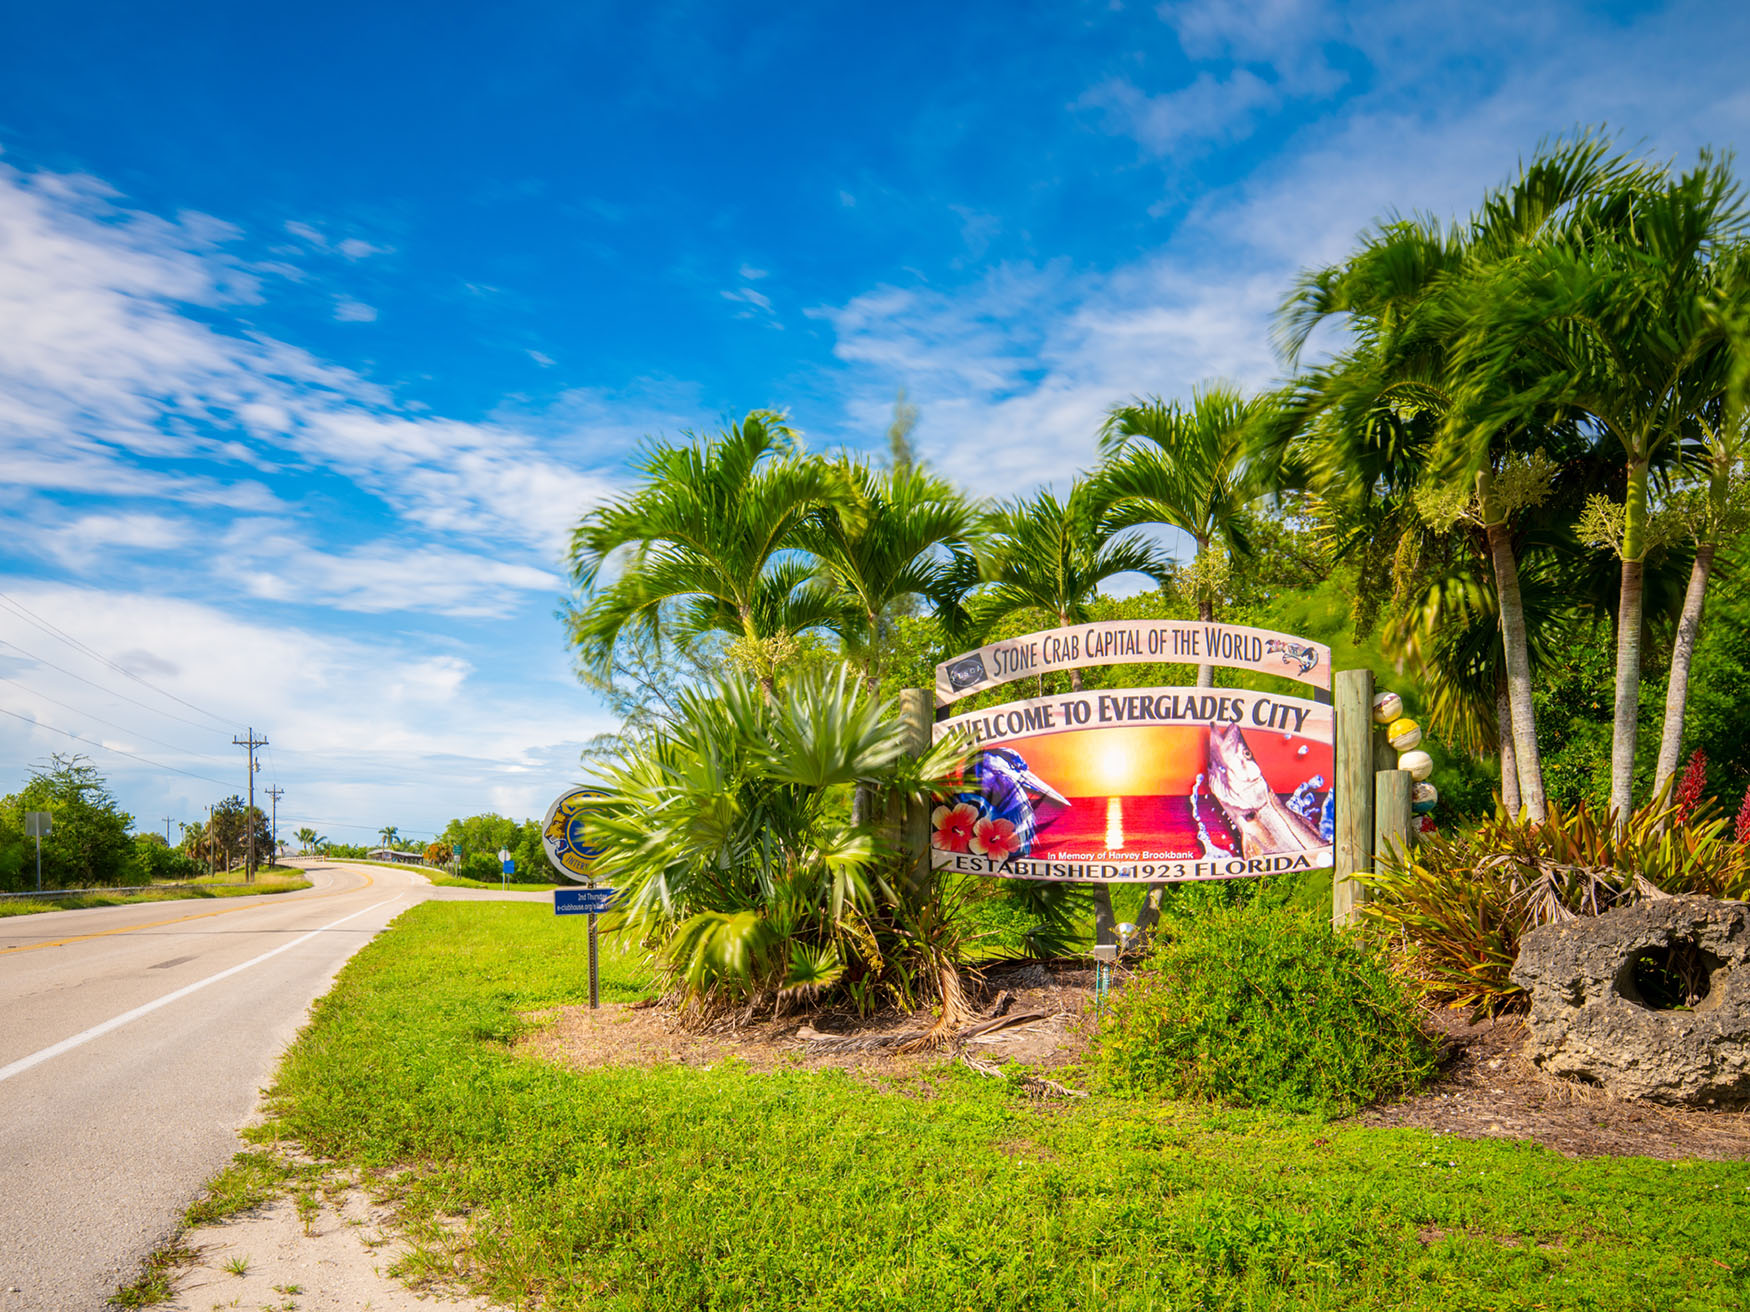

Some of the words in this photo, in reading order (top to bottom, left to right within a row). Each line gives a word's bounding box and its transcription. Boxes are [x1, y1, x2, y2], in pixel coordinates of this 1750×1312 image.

[993, 642, 1038, 677] STONE
[1042, 635, 1080, 665] CRAB
[1085, 629, 1143, 658] CAPITAL
[1148, 629, 1167, 655] OF
[1172, 629, 1200, 656] THE
[1205, 627, 1263, 662] WORLD
[1060, 699, 1091, 725] TO
[1098, 695, 1245, 723] EVERGLADES
[1252, 698, 1311, 733] CITY
[956, 856, 1119, 879] ESTABLISHED
[1130, 864, 1186, 879] 1923
[1195, 854, 1311, 877] FLORIDA
[1047, 852, 1056, 860] In
[1058, 851, 1094, 861] Memory
[1097, 851, 1106, 860] of
[1108, 851, 1141, 861] Harvey
[1143, 851, 1194, 860] Brookbank
[578, 893, 587, 901] 2nd
